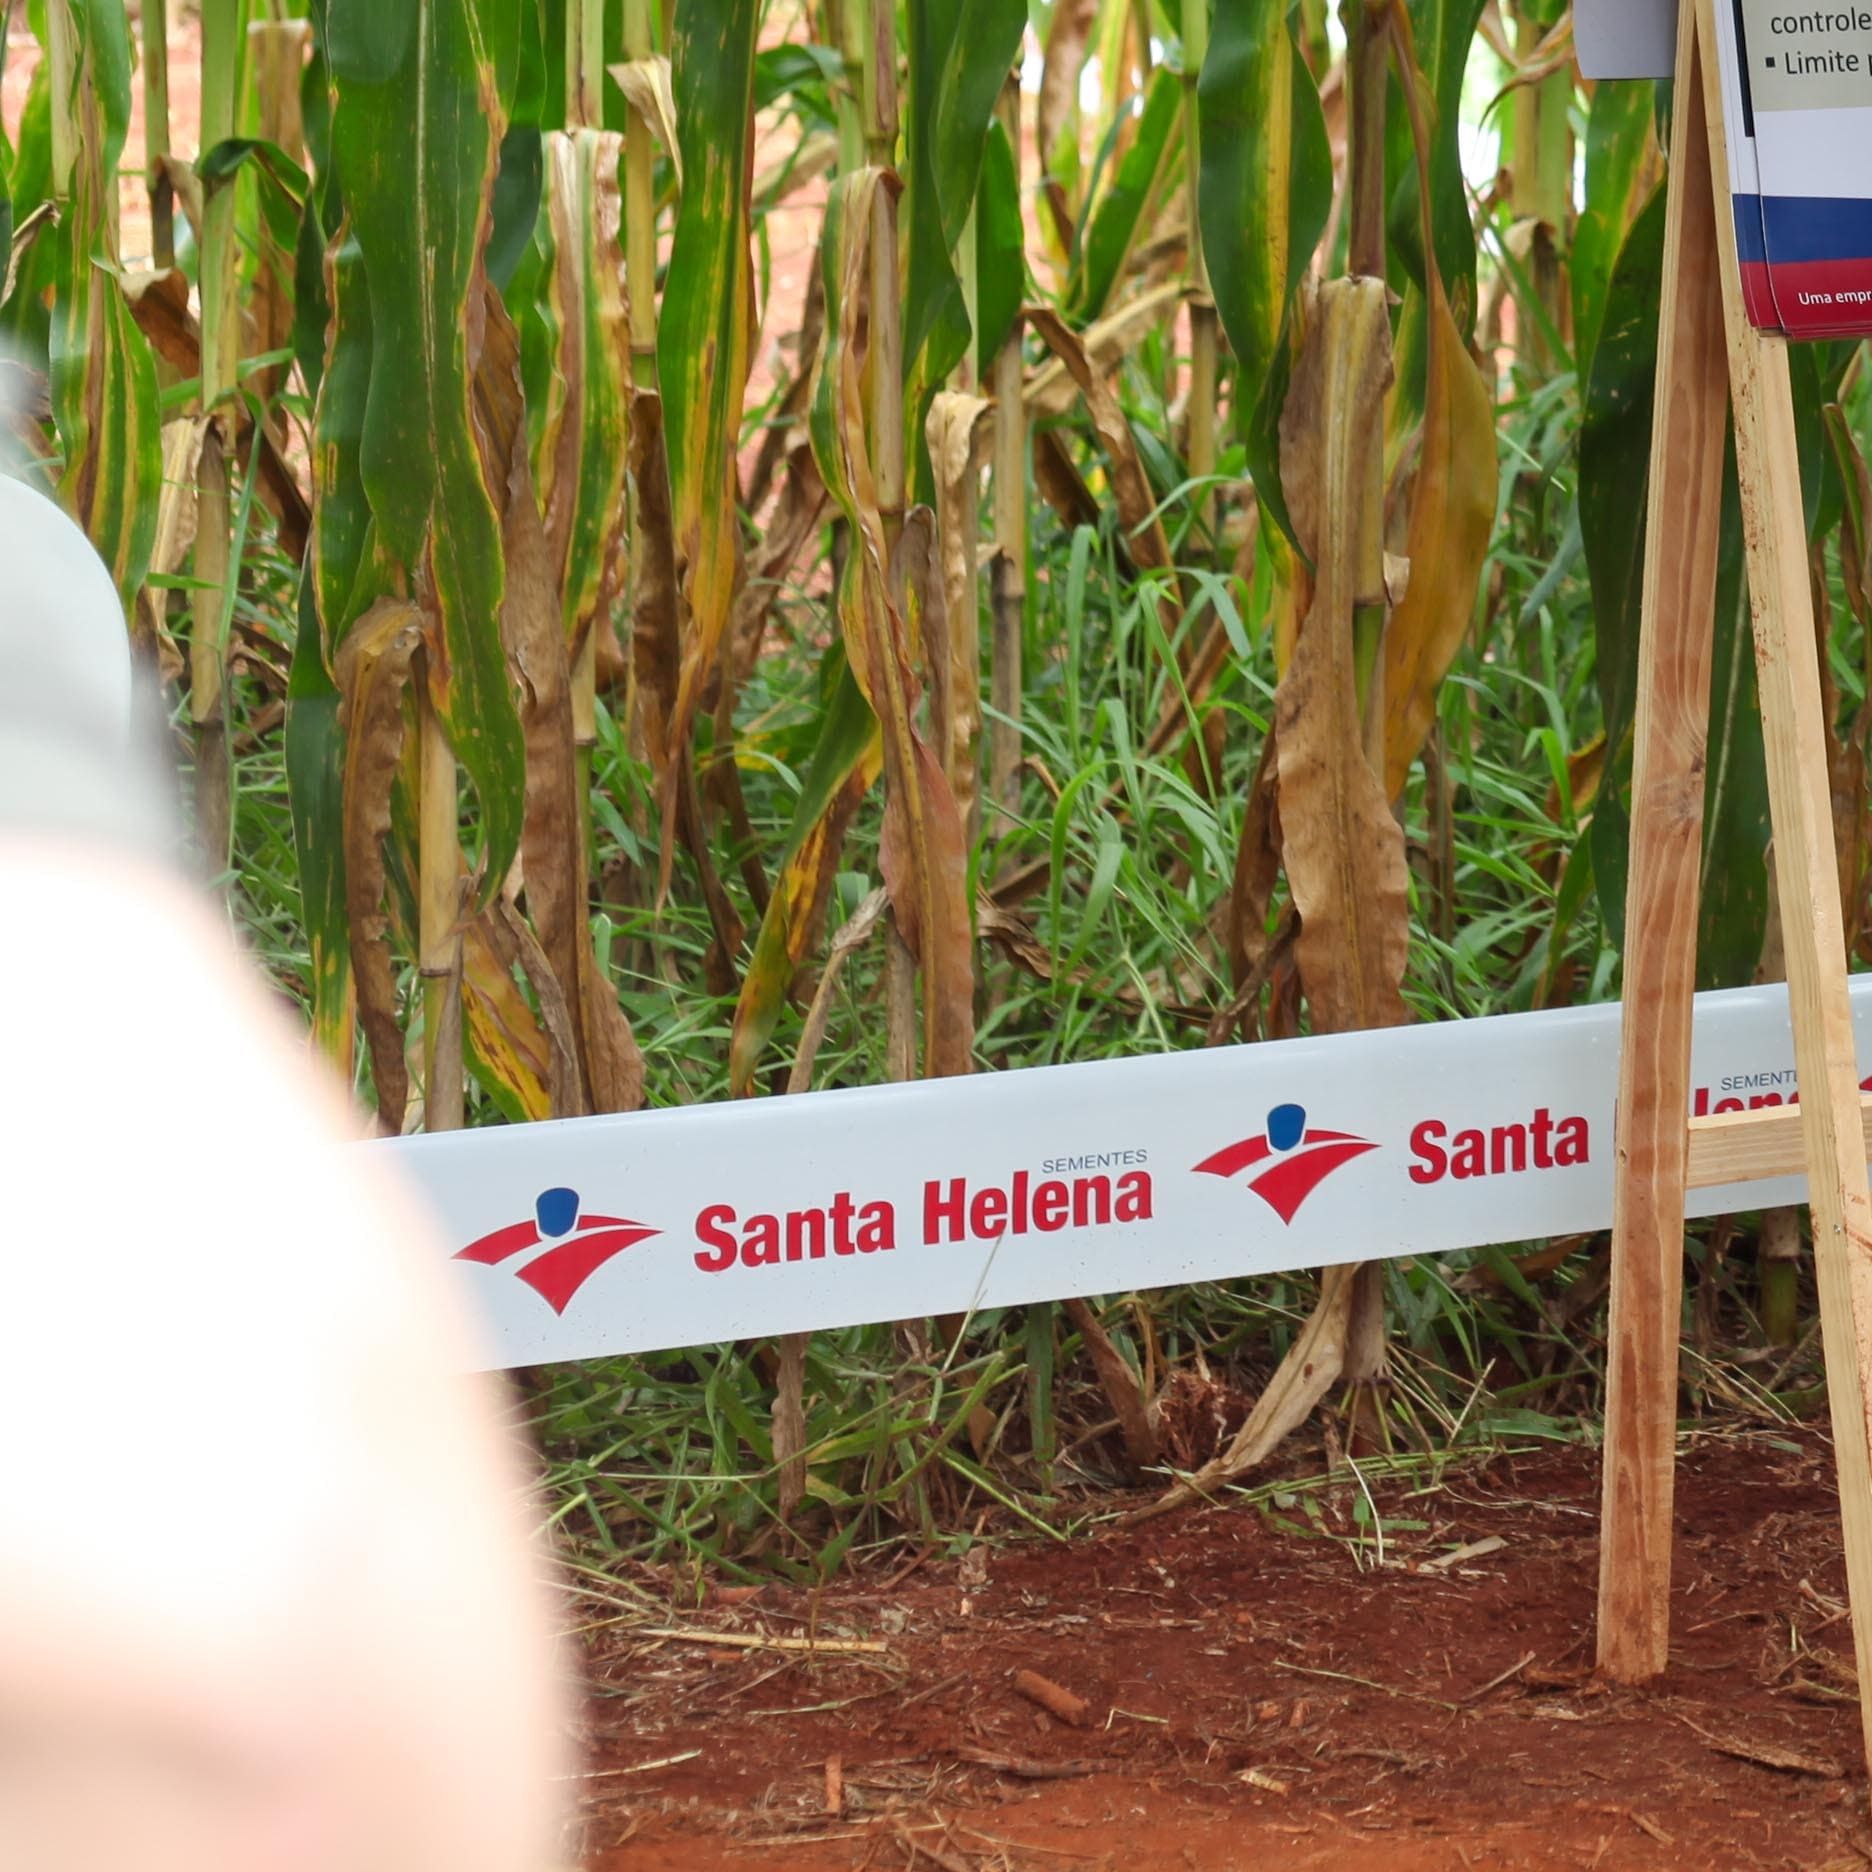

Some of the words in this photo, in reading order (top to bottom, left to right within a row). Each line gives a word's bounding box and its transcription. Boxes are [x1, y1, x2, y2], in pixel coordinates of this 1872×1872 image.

[1771, 7, 1871, 34] controle
[1785, 50, 1858, 74] Limite
[1799, 292, 1832, 305] Uma
[1409, 1108, 1589, 1184] Santa
[1042, 1148, 1148, 1174] SEMENTES
[695, 1192, 895, 1272] Santa
[923, 1170, 1153, 1245] Helena
